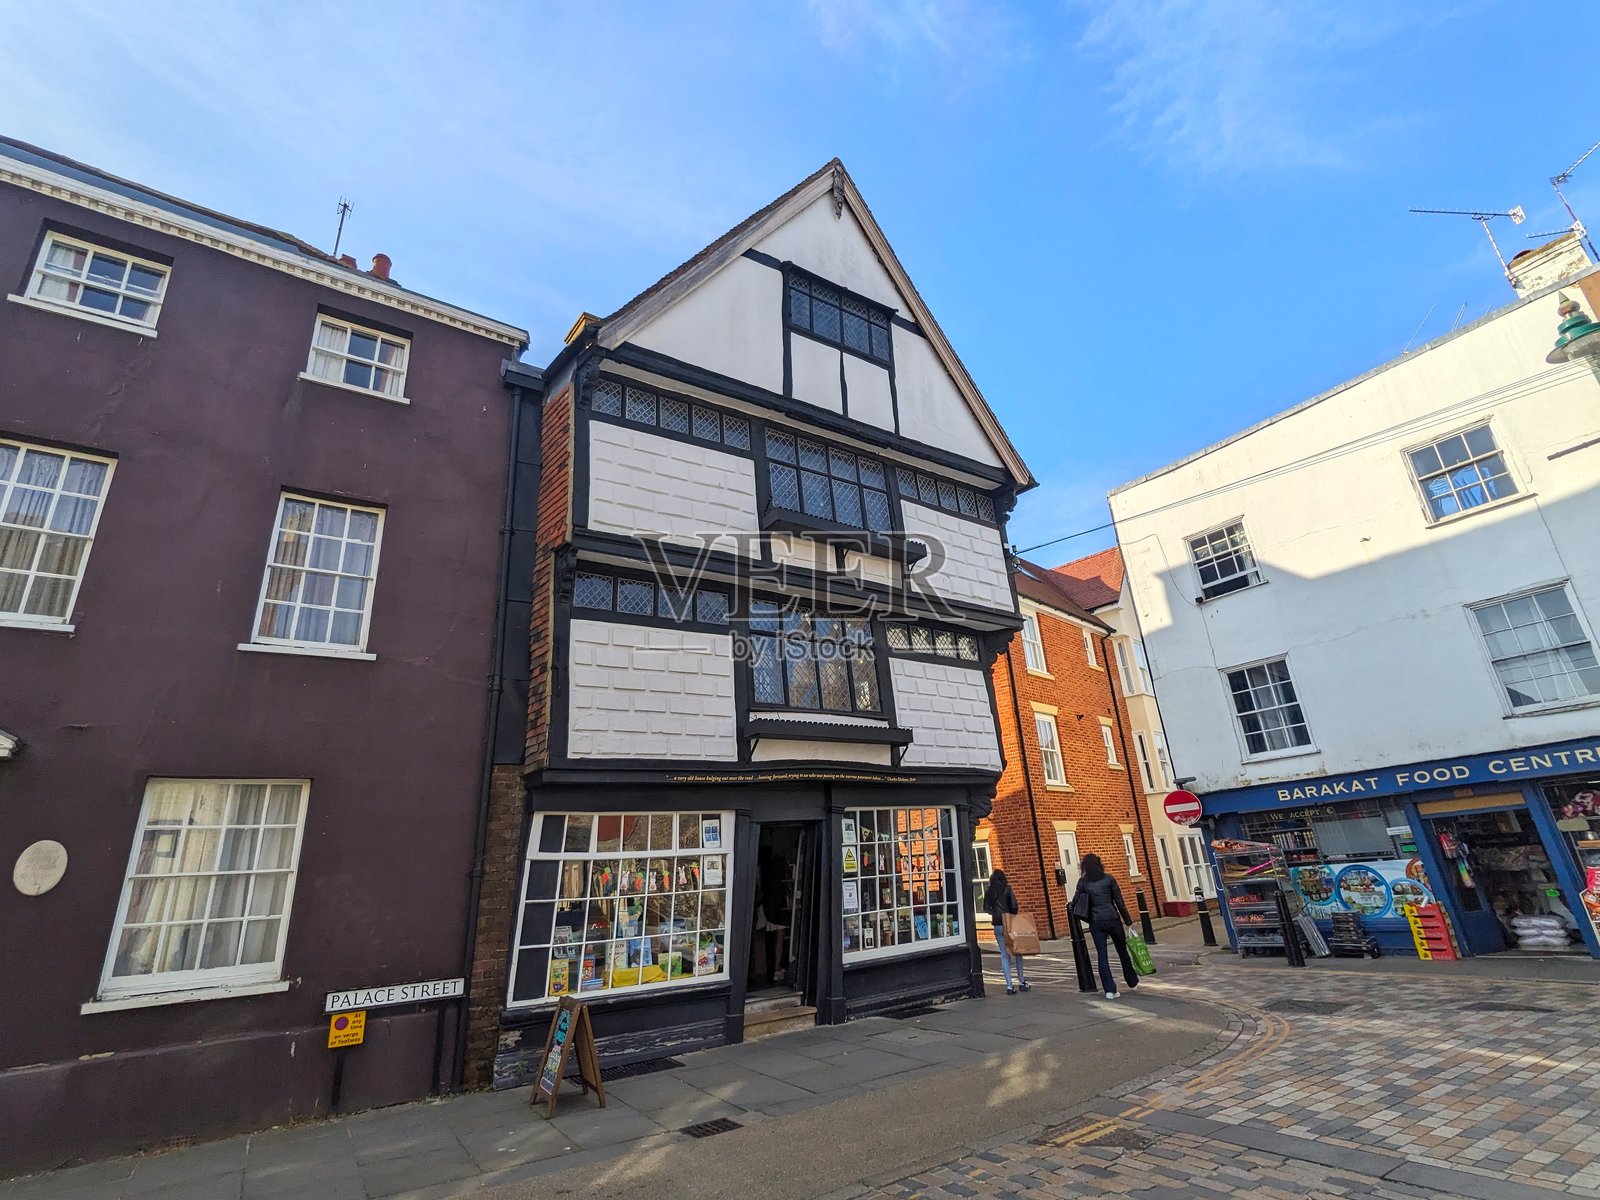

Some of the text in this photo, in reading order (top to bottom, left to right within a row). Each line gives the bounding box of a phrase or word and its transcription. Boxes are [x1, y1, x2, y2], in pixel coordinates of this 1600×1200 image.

[1277, 777, 1378, 802] BARAKAT
[1396, 766, 1470, 788] FOOD
[1270, 812, 1284, 821] WE
[1289, 808, 1321, 819] ACCEPT
[331, 980, 460, 1009] PALACE STREET
